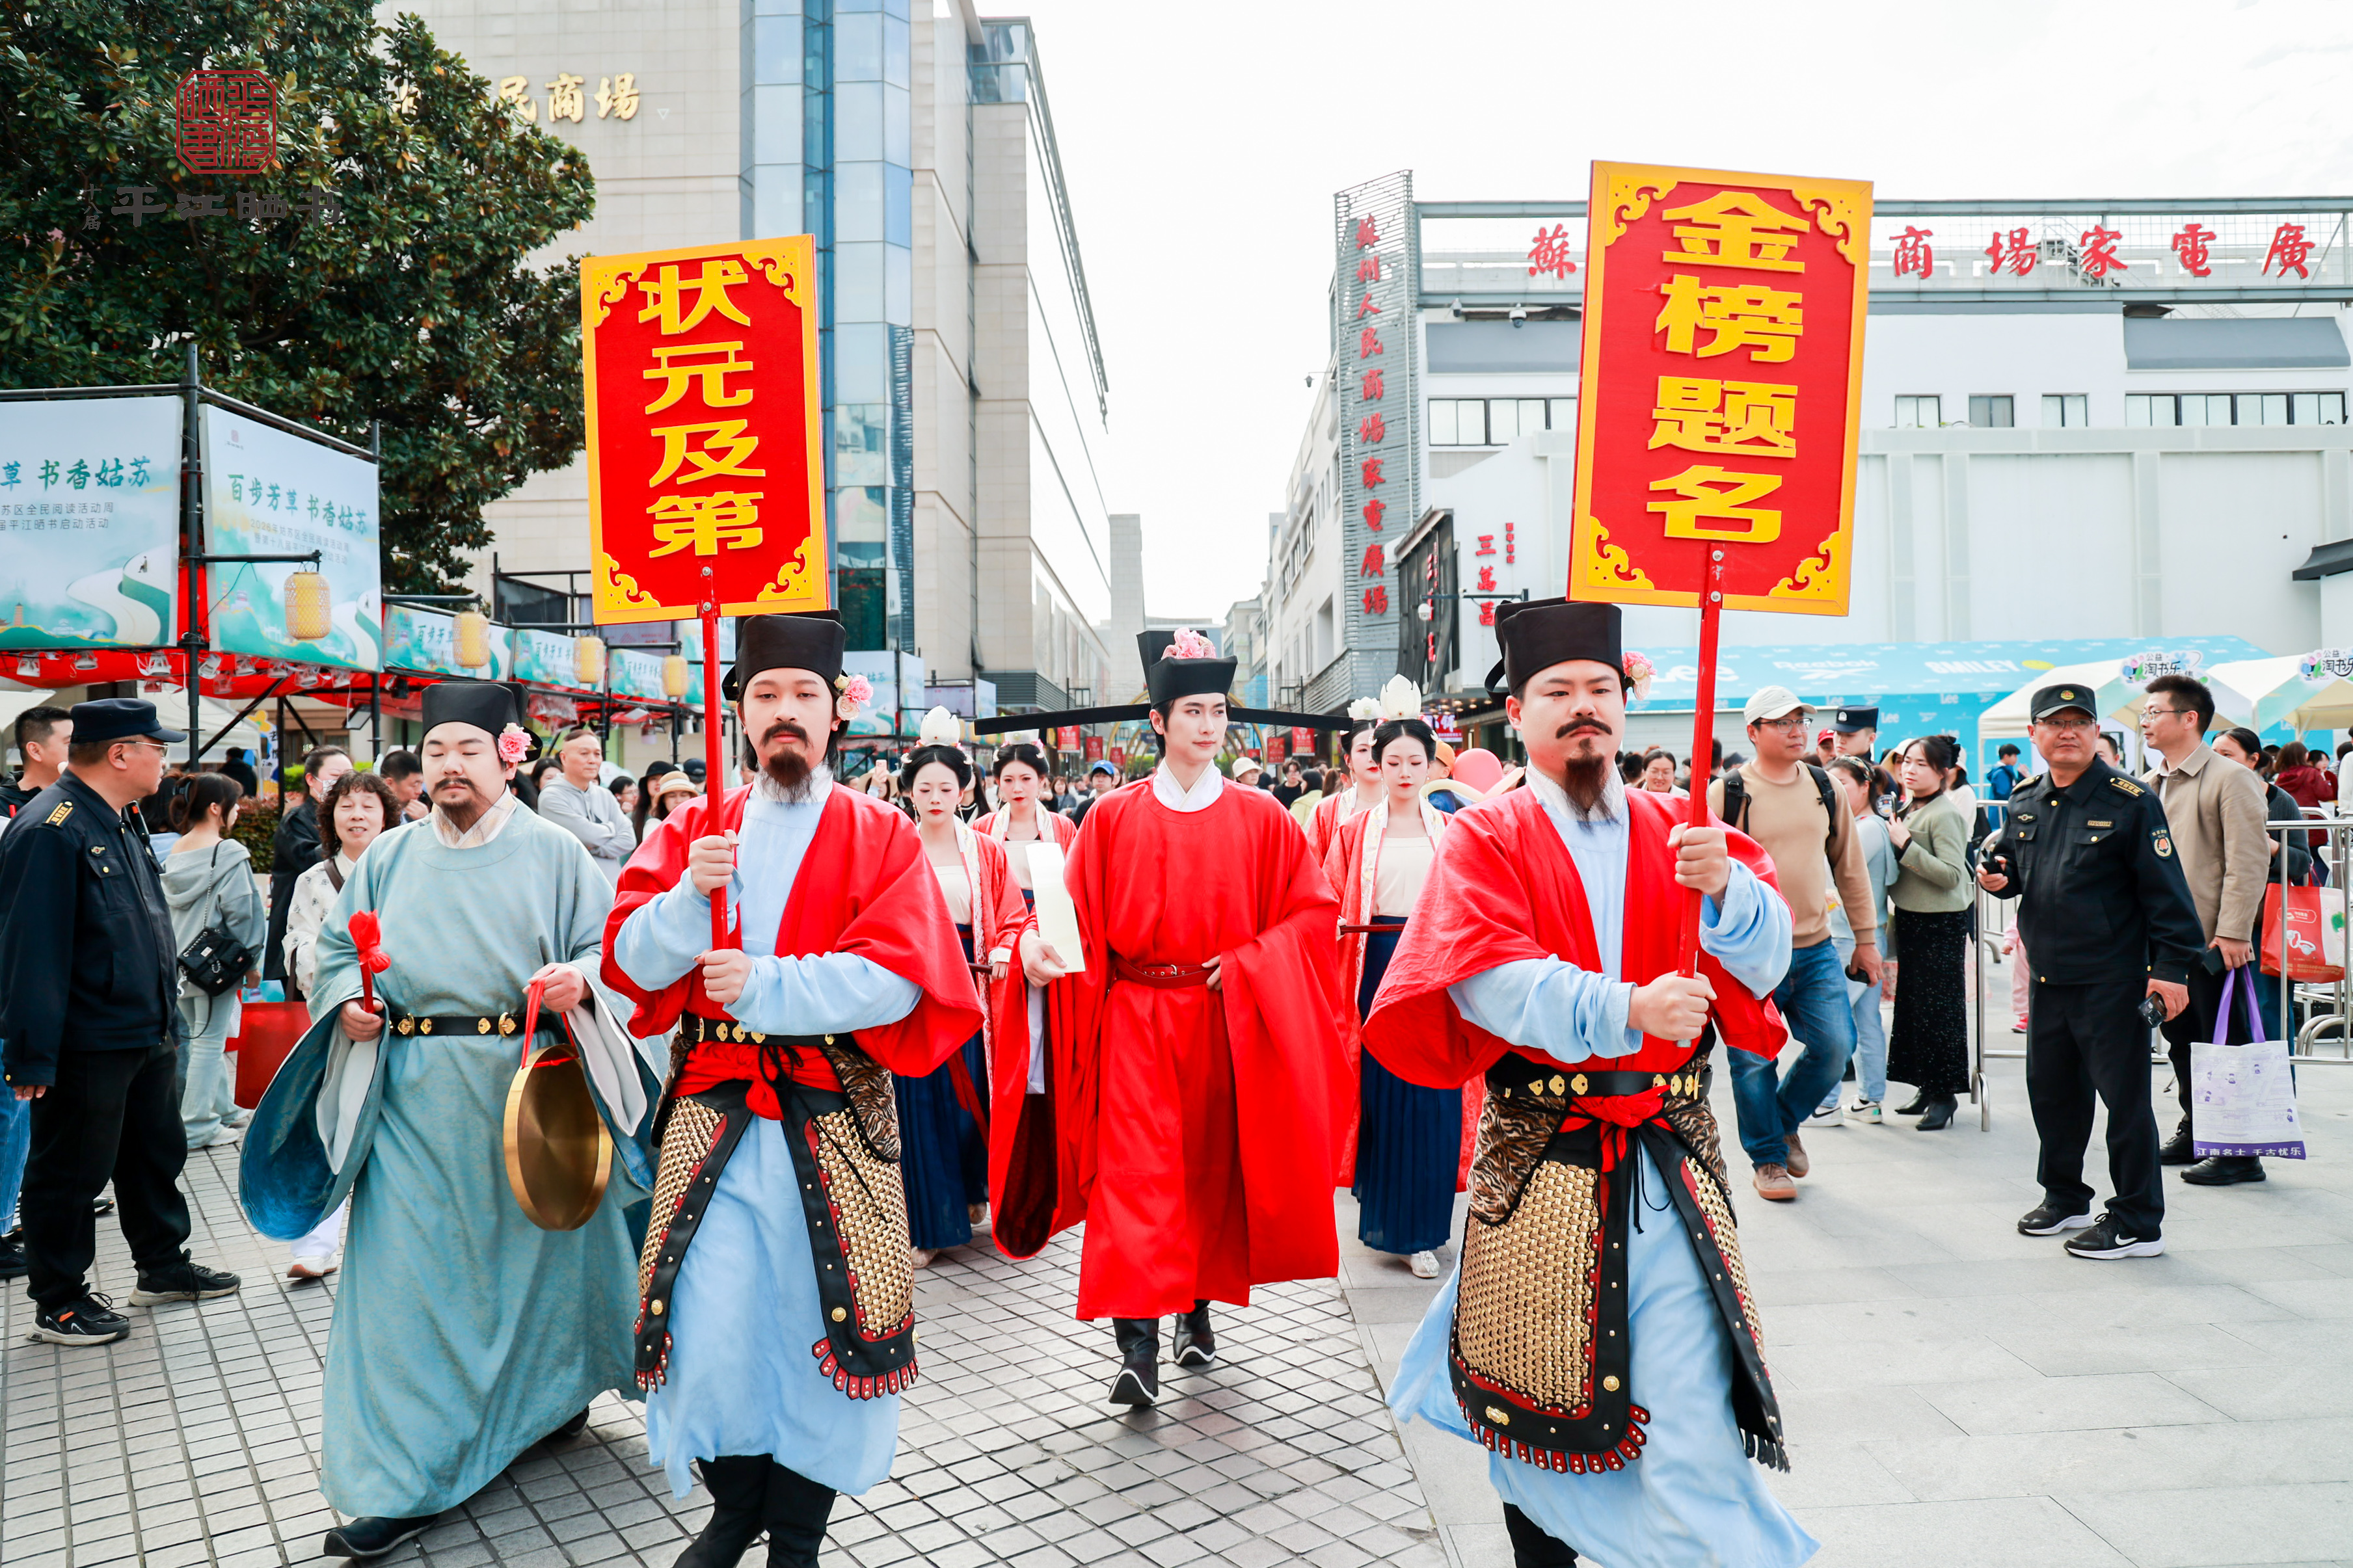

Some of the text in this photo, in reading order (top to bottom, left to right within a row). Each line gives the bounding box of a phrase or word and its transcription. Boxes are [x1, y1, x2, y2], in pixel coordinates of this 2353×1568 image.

[1647, 191, 1810, 543] 金榜题名
[638, 259, 766, 558] 状元及第
[38, 455, 150, 491] 书香姑苏
[228, 473, 367, 535] 百步芳草 书香姑苏
[1475, 535, 1497, 626] 三萬昌
[2196, 1147, 2302, 1156] 江南名士 千古忧乐
